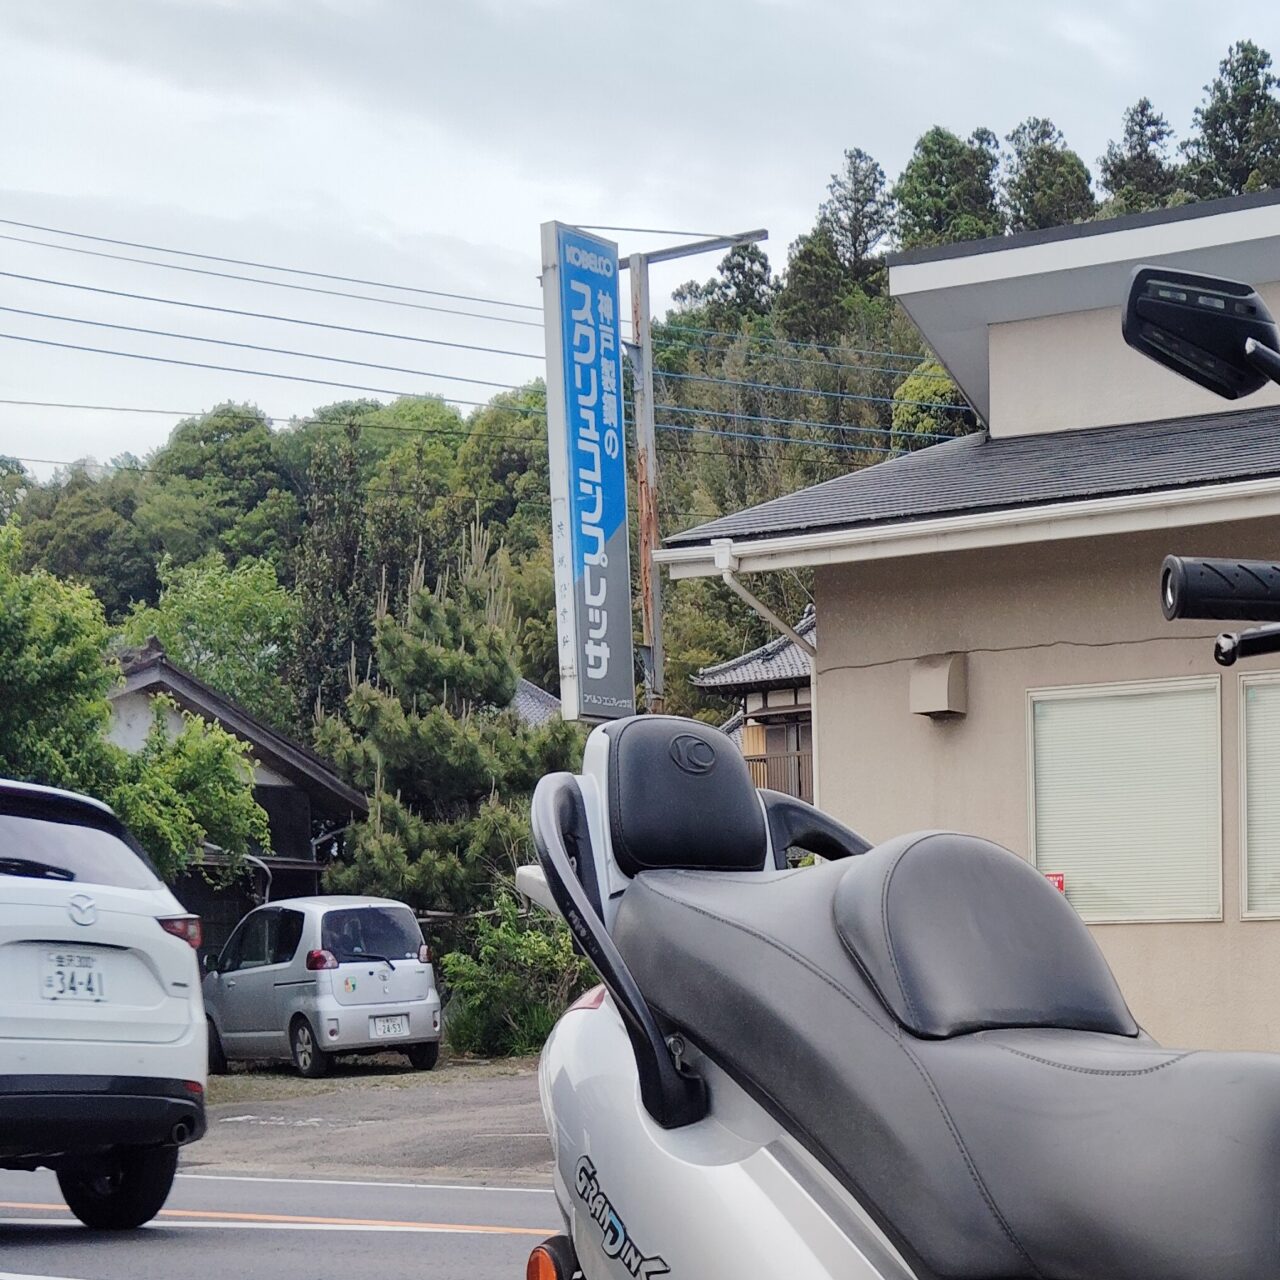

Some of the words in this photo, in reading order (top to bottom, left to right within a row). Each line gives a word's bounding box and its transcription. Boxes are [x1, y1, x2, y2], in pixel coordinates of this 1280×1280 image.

[566, 244, 614, 278] KOBELCO
[570, 279, 611, 680] スクリュコンプレッサ
